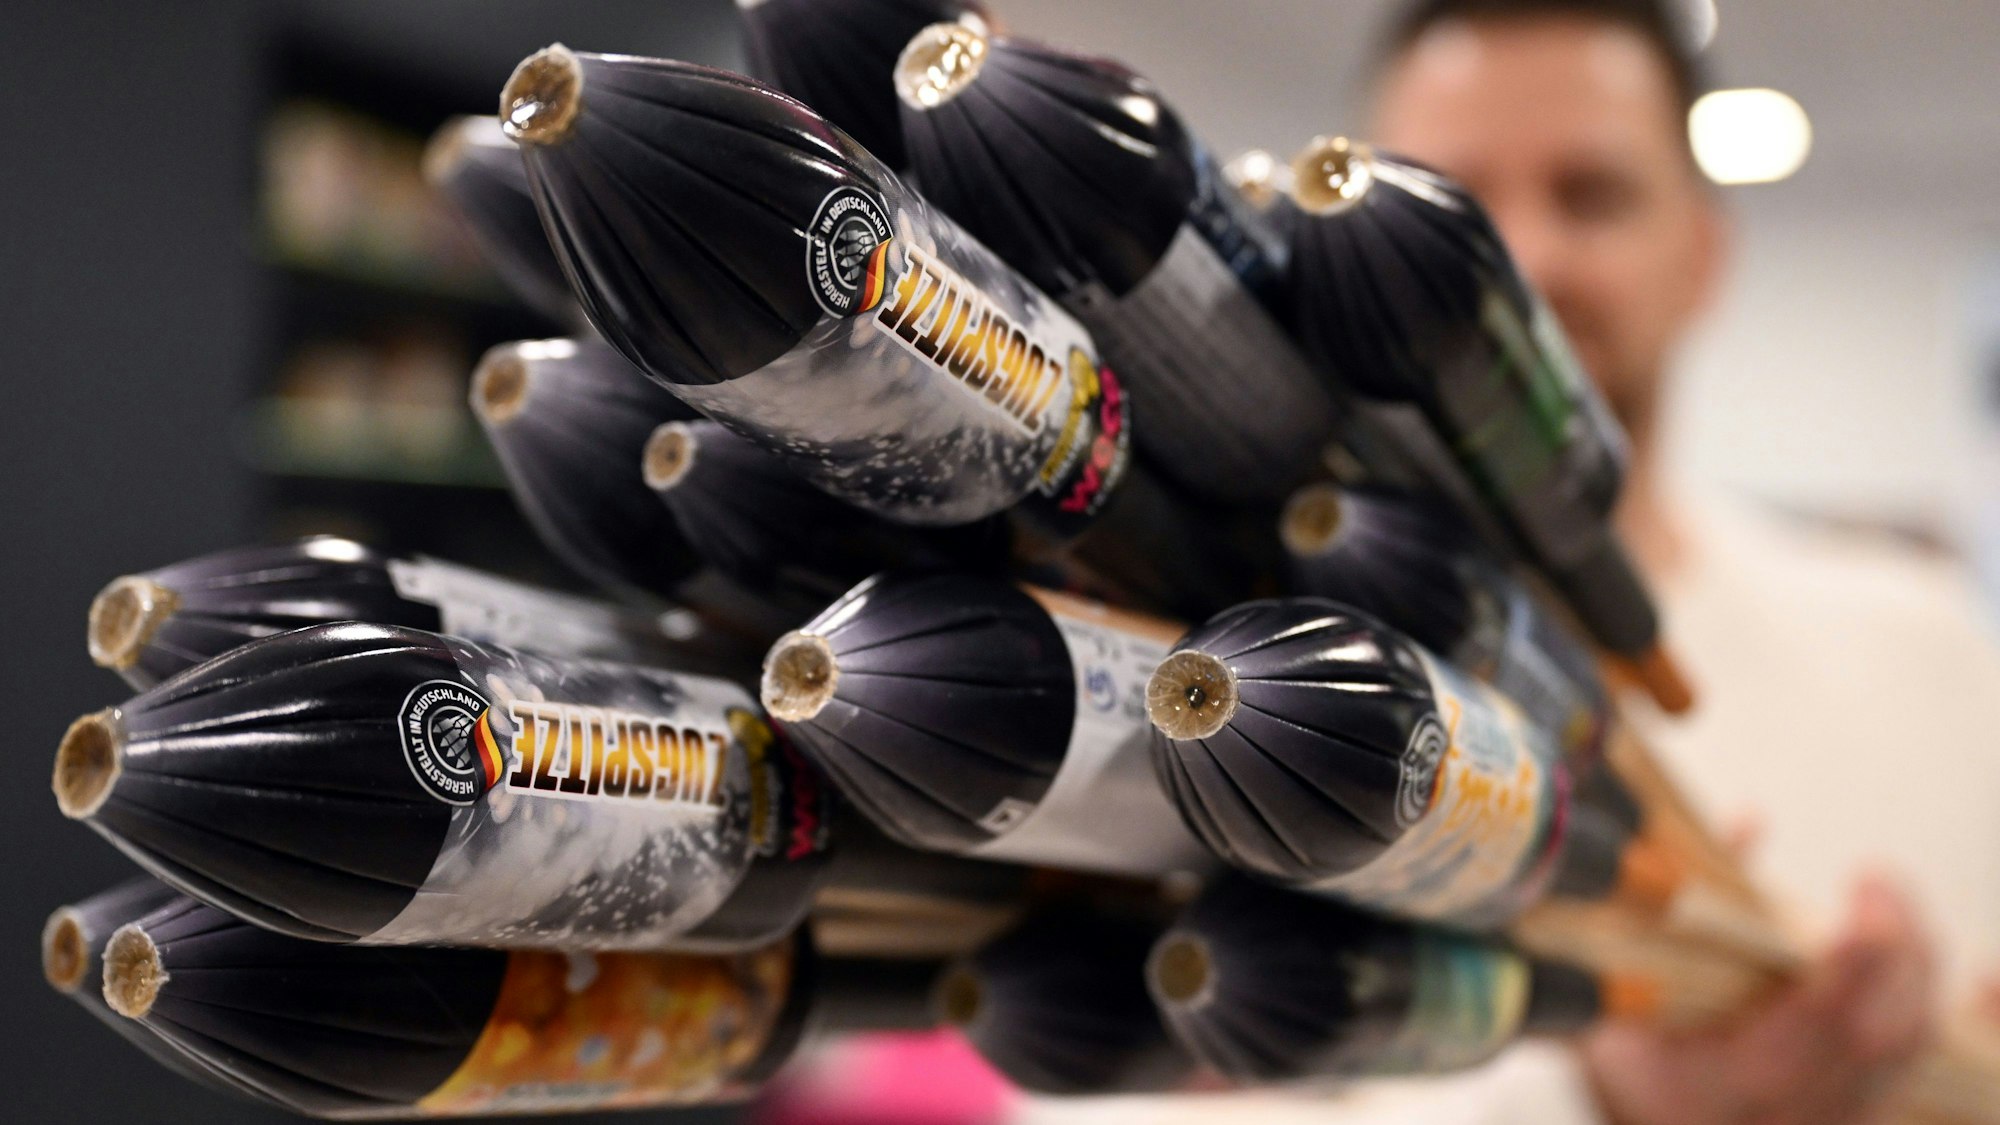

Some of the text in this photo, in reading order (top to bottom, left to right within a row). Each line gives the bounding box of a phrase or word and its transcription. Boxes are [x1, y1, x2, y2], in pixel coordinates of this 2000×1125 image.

[820, 216, 834, 234] IN
[828, 197, 886, 237] DEUTSCHLAND
[876, 247, 1062, 433] ZUGSPITZE
[411, 736, 474, 795] HERGESTELLT
[509, 708, 726, 806] ZUGSPITZE
